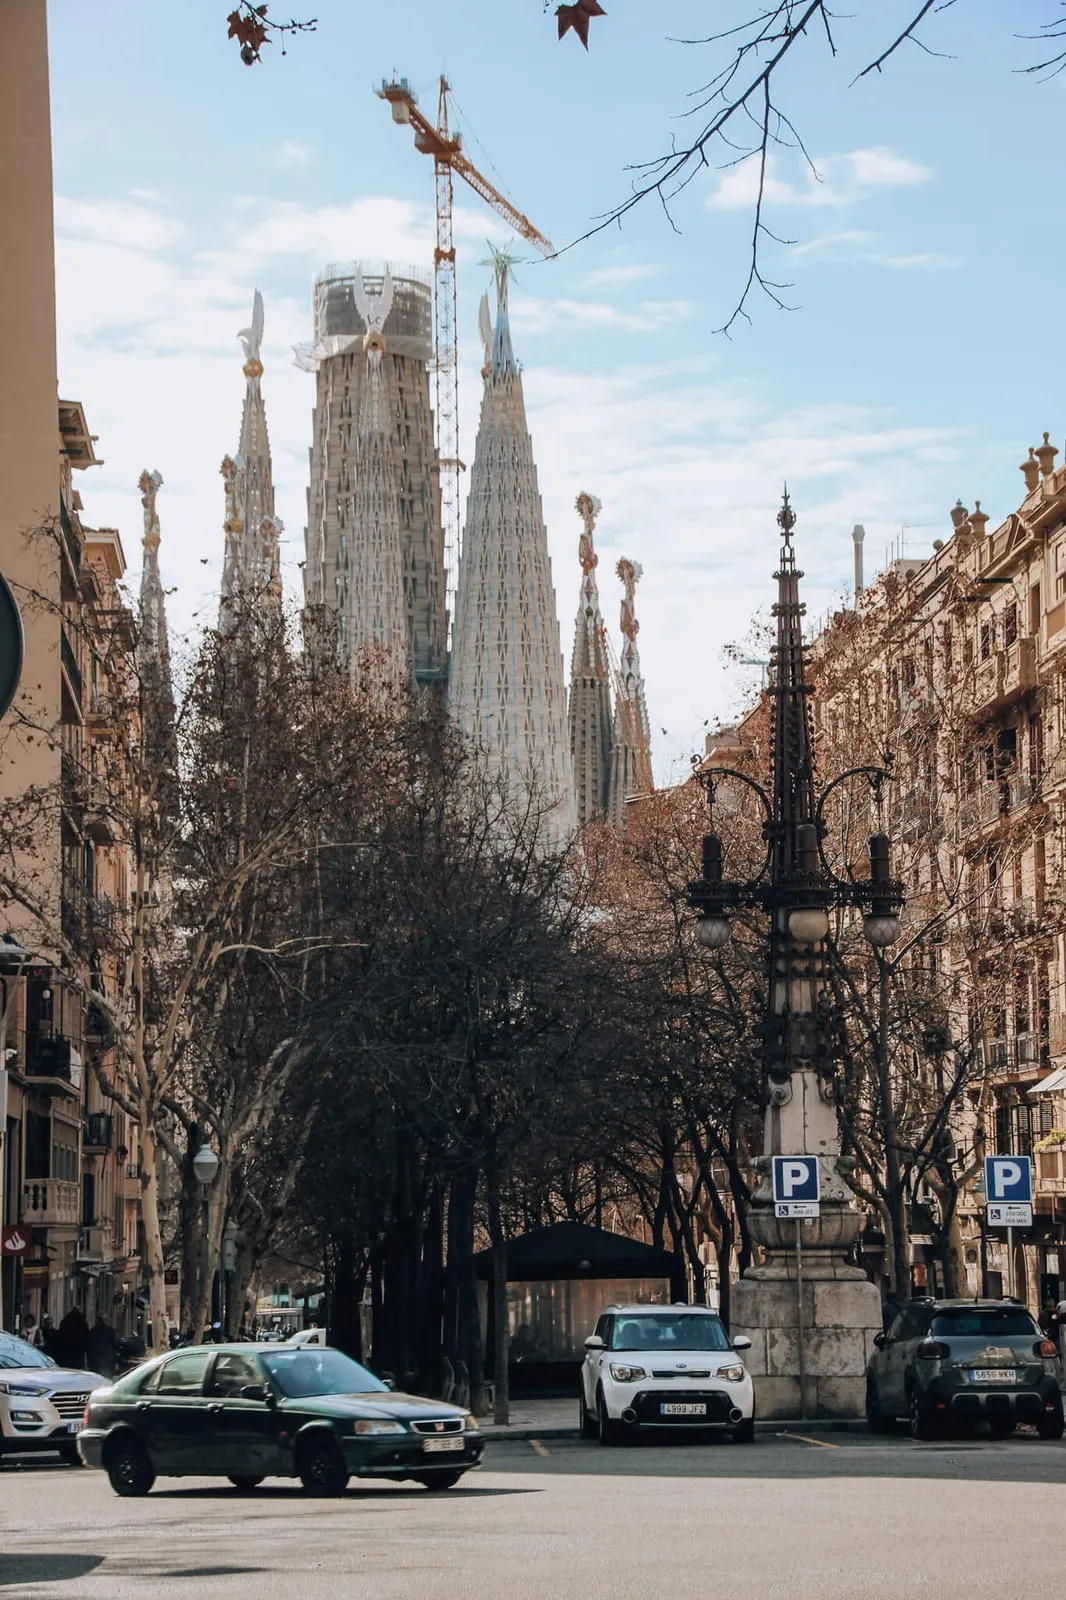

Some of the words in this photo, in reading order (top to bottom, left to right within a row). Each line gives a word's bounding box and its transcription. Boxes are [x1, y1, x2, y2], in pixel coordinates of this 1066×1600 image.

[782, 1161, 810, 1197] P
[993, 1160, 1022, 1197] P
[666, 1405, 687, 1413] 4999
[689, 1405, 705, 1413] JFZ
